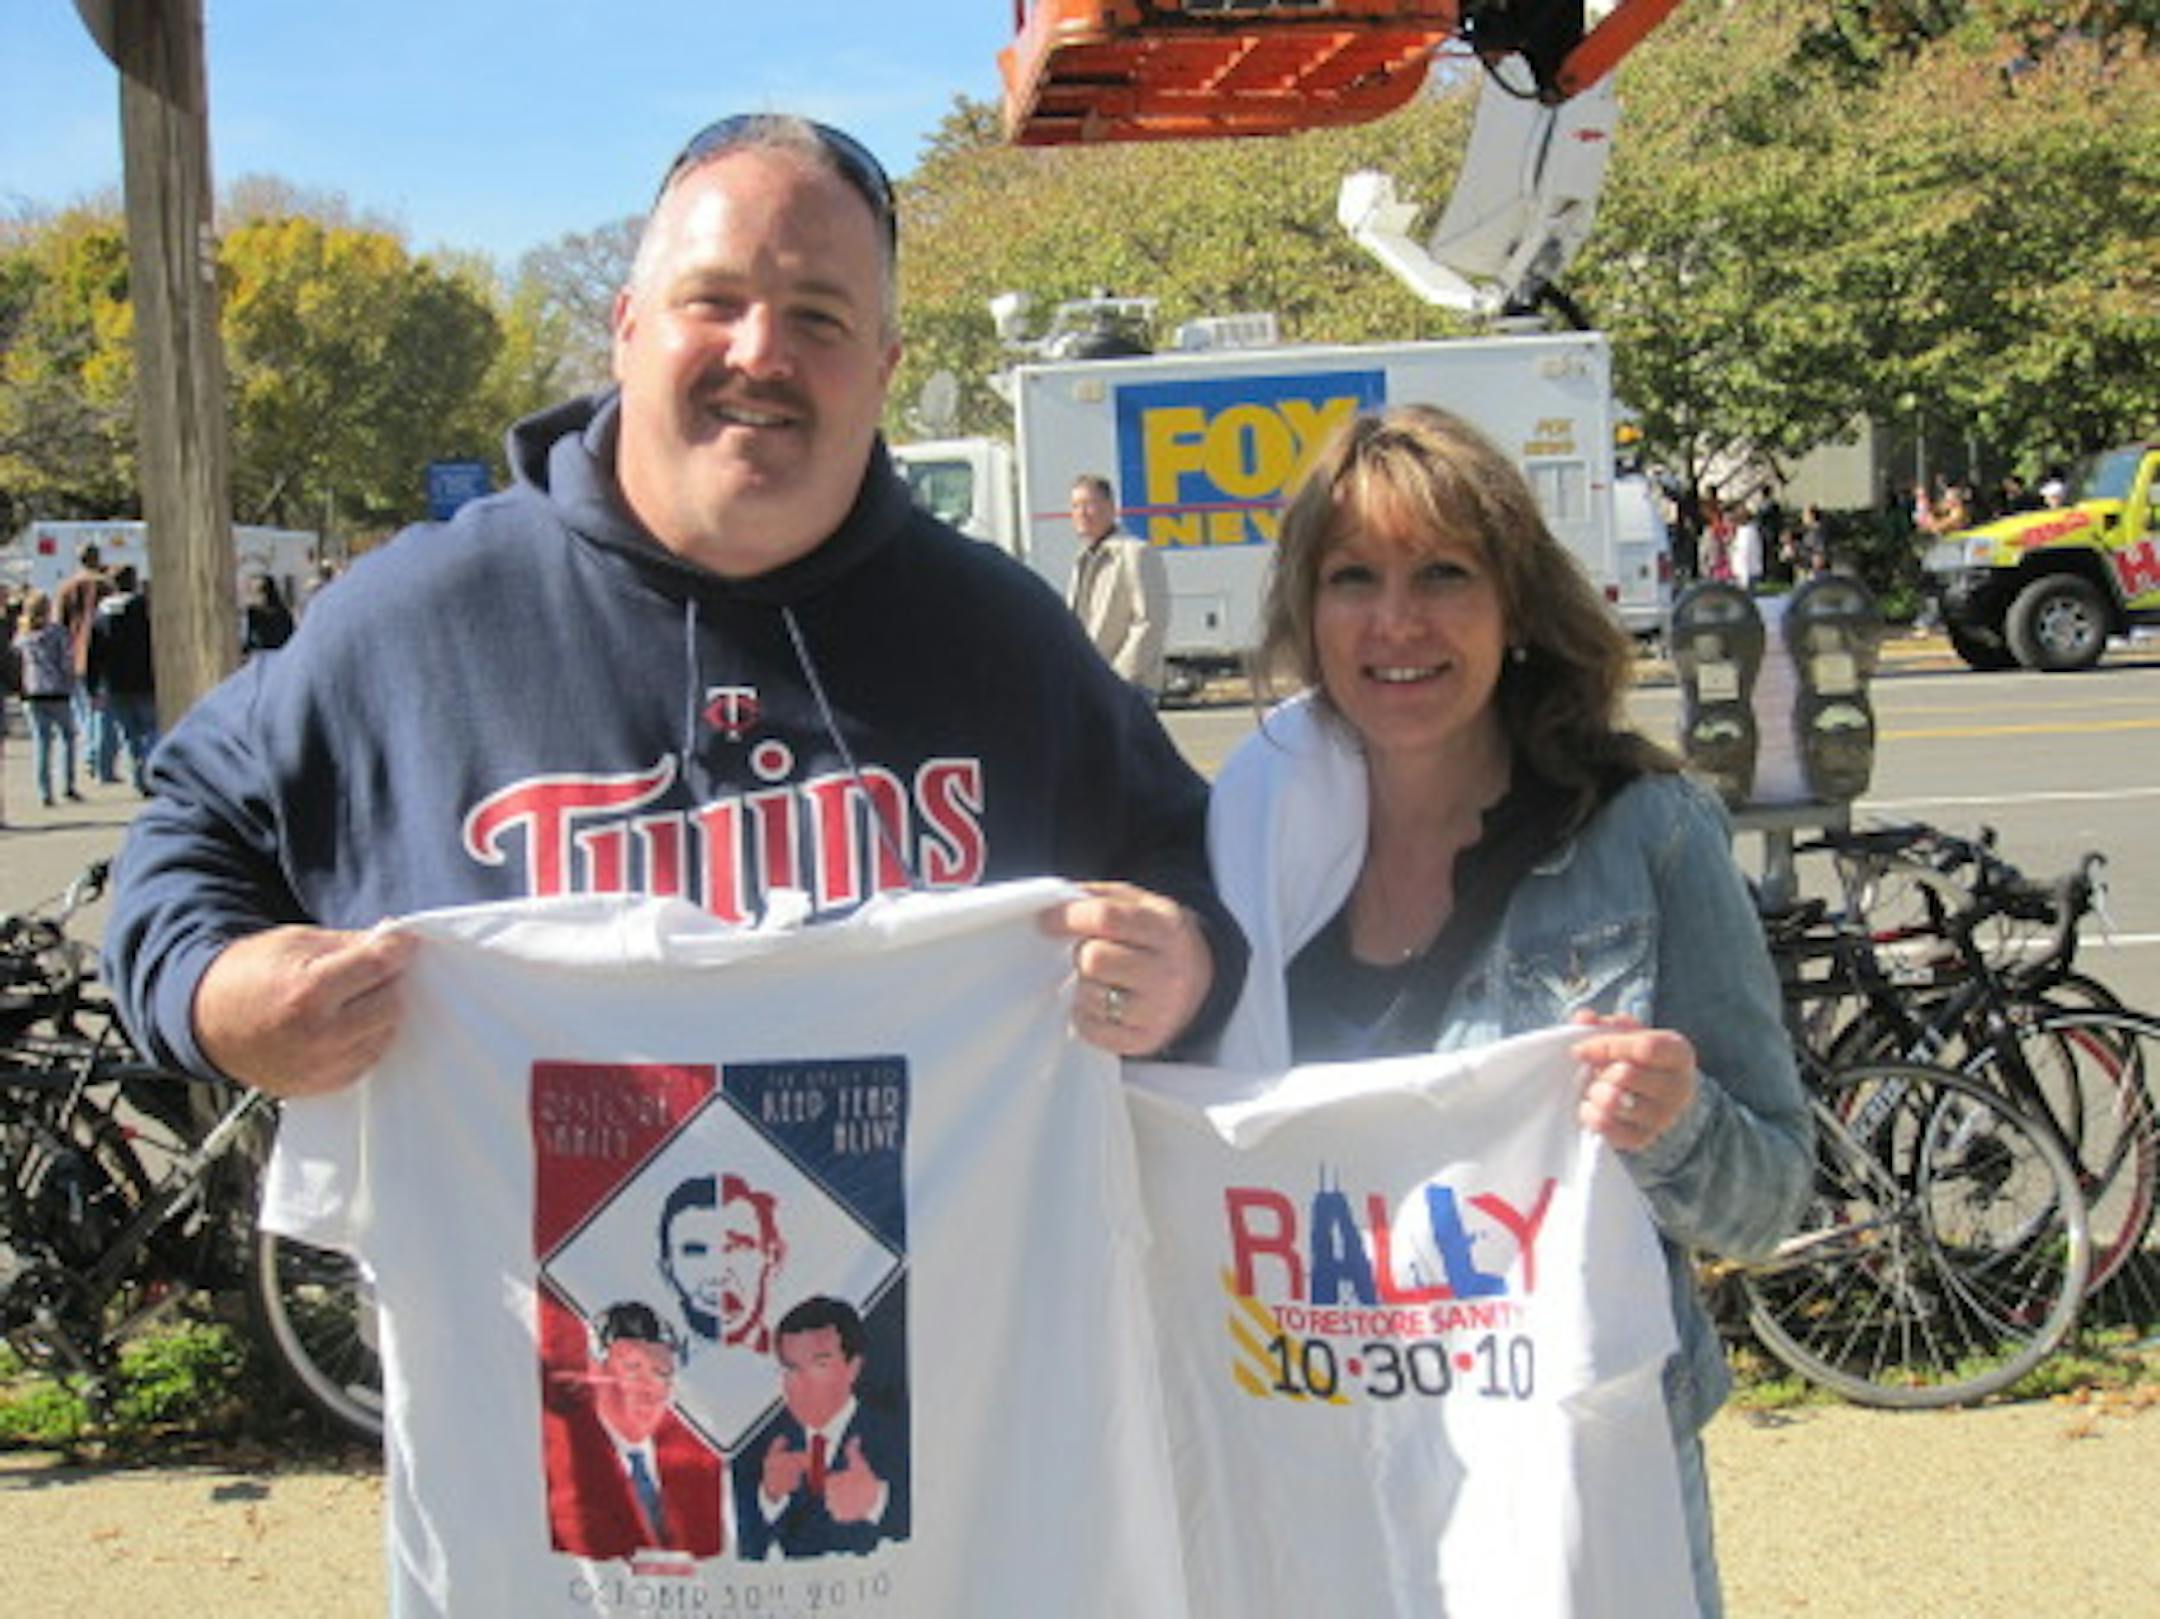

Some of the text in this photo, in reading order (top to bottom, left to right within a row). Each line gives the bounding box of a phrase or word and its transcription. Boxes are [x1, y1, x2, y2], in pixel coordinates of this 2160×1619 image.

[1143, 396, 1360, 504] FOX
[463, 740, 986, 929] Twins
[1225, 1167, 1557, 1304] RALLY
[1308, 1309, 1425, 1337] RESTORE
[806, 1571, 891, 1610] 2010
